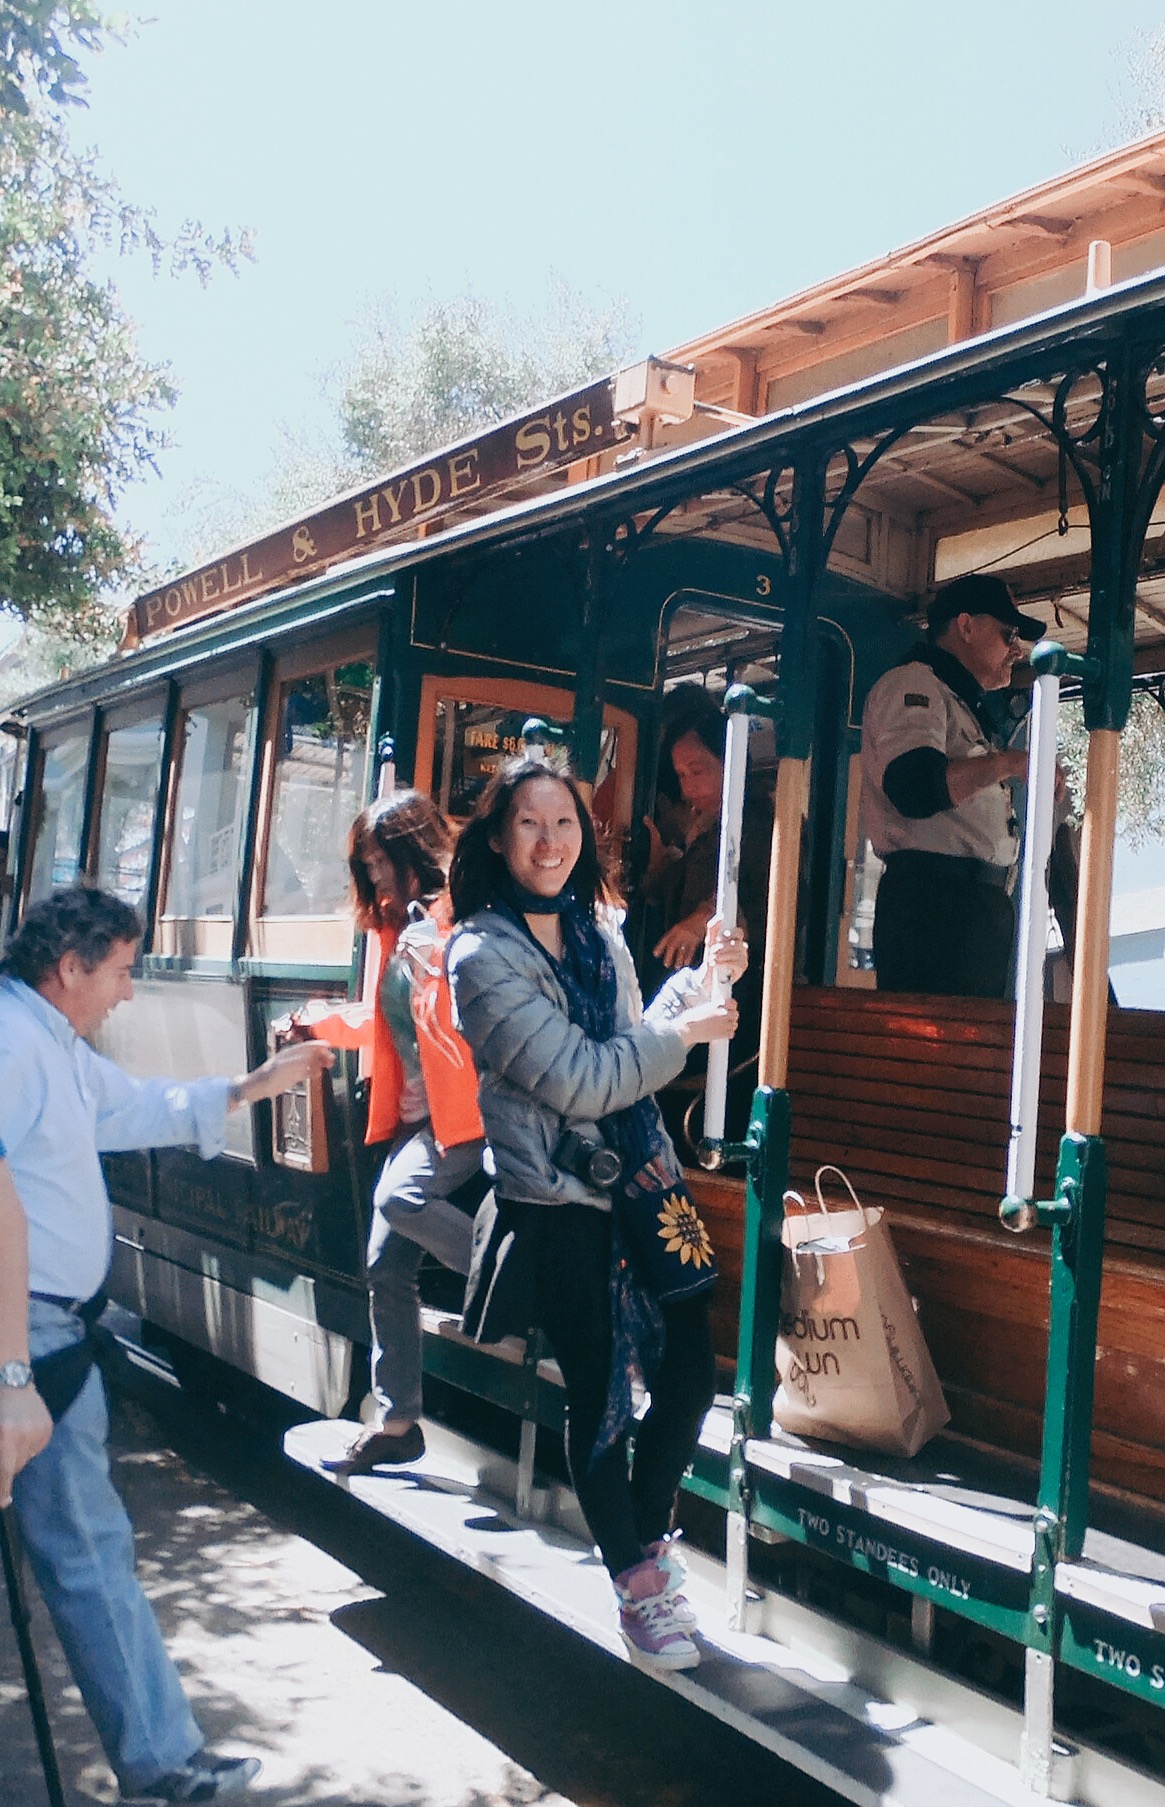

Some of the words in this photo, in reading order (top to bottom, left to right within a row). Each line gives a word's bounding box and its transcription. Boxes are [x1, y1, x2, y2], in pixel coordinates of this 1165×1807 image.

[144, 553, 264, 628] POWELL
[292, 526, 318, 564] &
[353, 448, 481, 539] HYDE
[514, 404, 603, 470] Sts.
[756, 575, 772, 596] 3
[798, 1507, 830, 1537] TWO
[835, 1525, 920, 1579] STANDEES
[927, 1567, 972, 1601] ONLY
[1094, 1638, 1142, 1679] TWO
